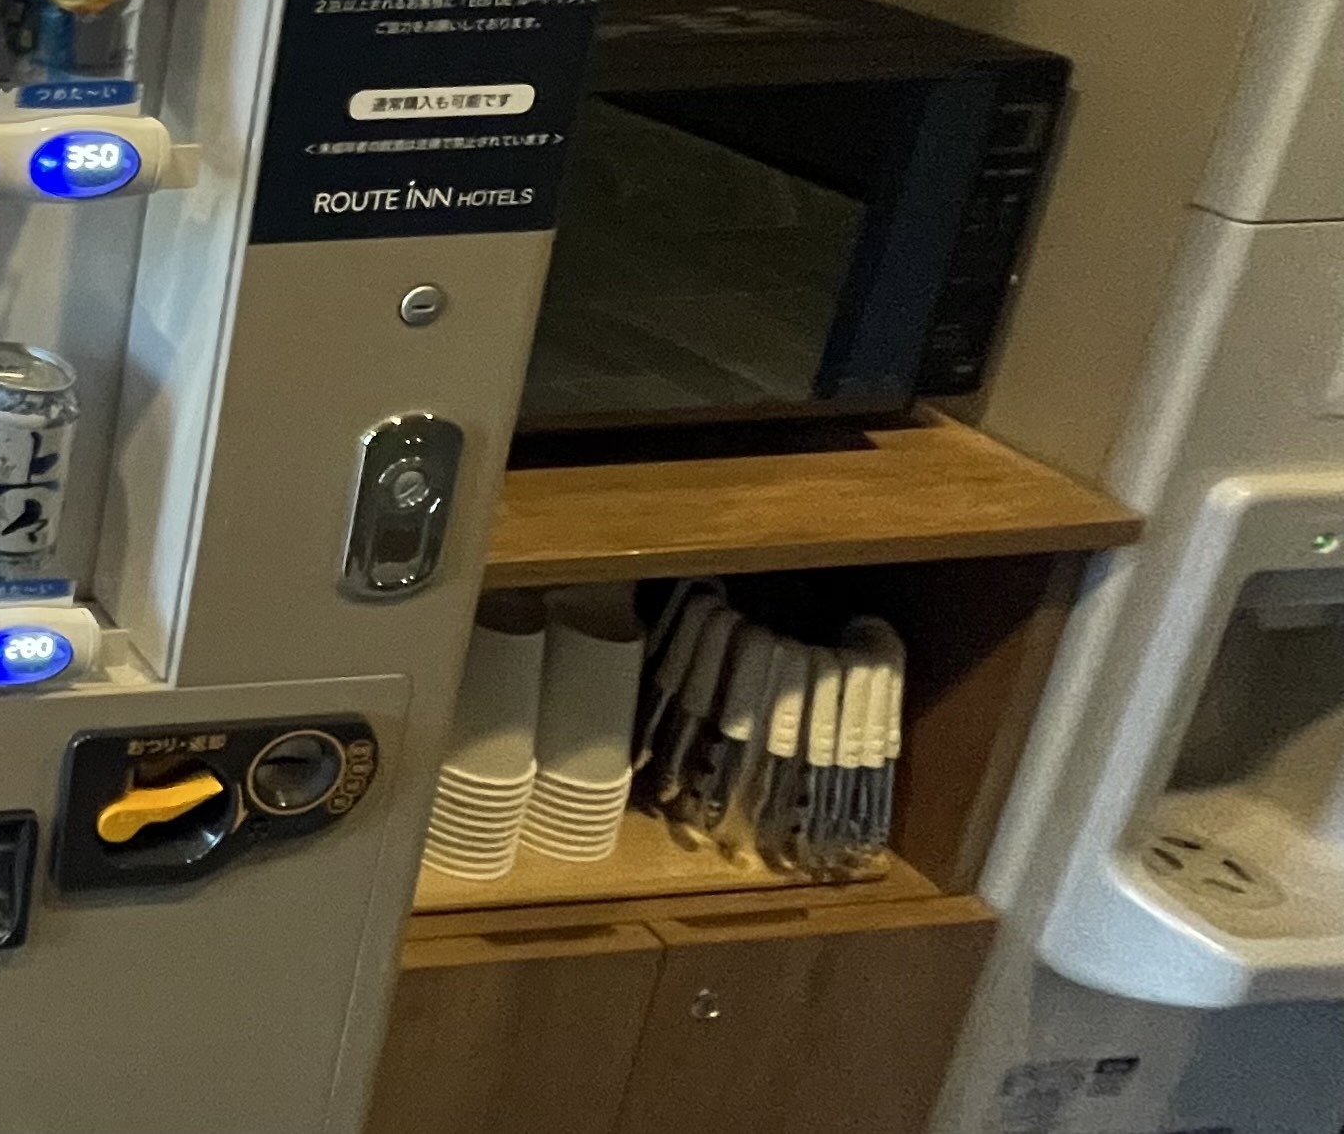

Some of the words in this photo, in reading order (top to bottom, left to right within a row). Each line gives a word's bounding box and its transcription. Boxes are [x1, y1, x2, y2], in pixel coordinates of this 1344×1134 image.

[68, 143, 119, 169] 350
[314, 189, 401, 213] ROUTE
[457, 188, 534, 206] HOTELS
[5, 636, 53, 659] 280
